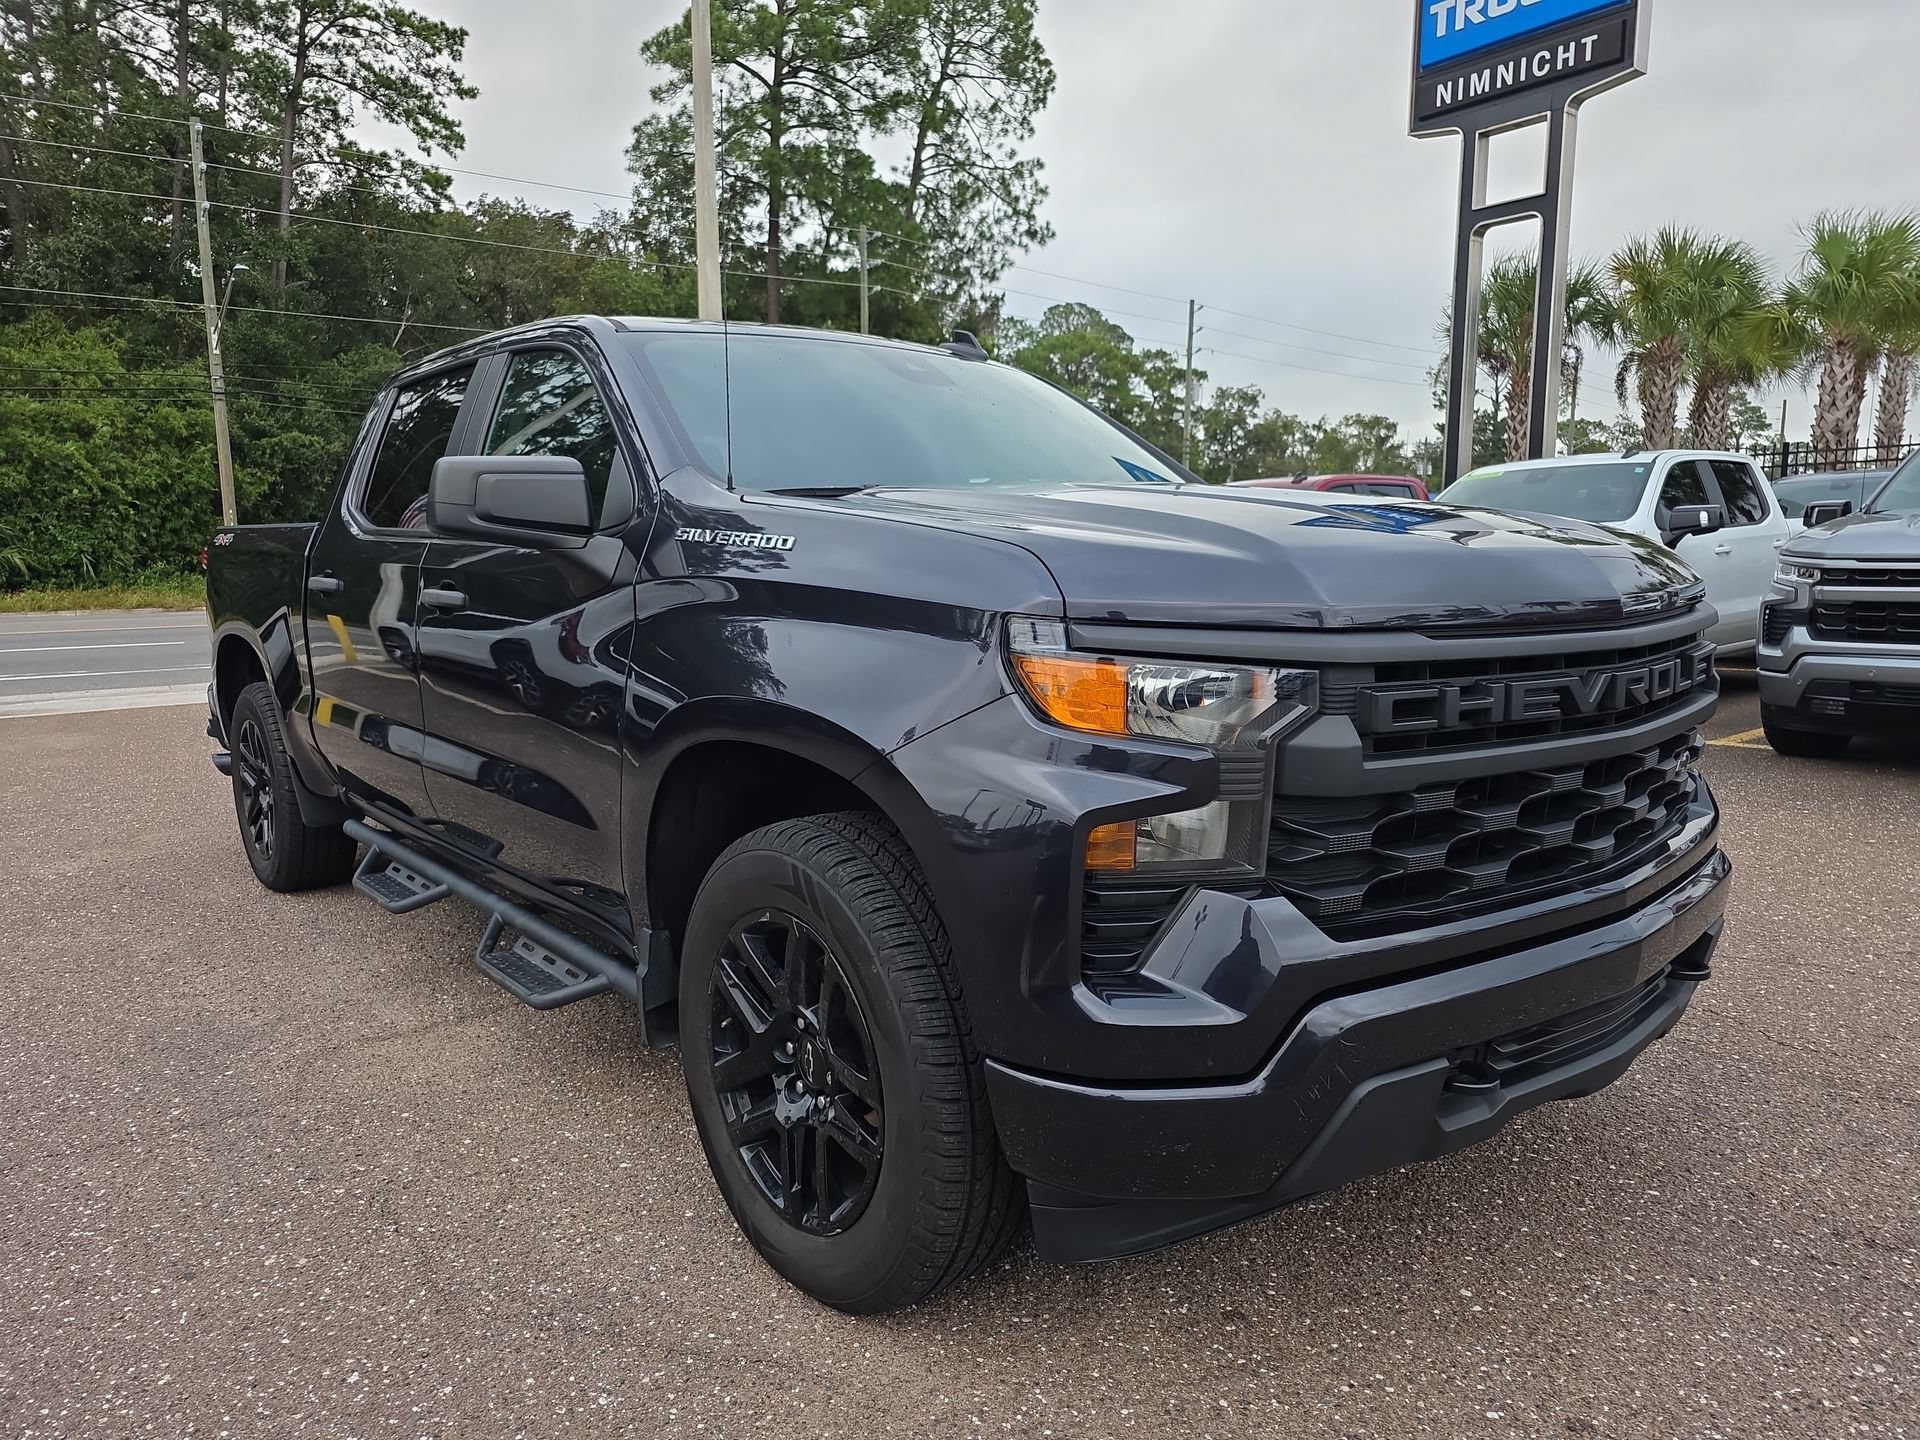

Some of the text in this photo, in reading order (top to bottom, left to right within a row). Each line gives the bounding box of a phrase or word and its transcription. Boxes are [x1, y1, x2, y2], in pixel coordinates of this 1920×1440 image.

[1430, 0, 1546, 37] TRU
[1436, 34, 1598, 108] NIMNICHT
[675, 527, 796, 550] SILVERADO
